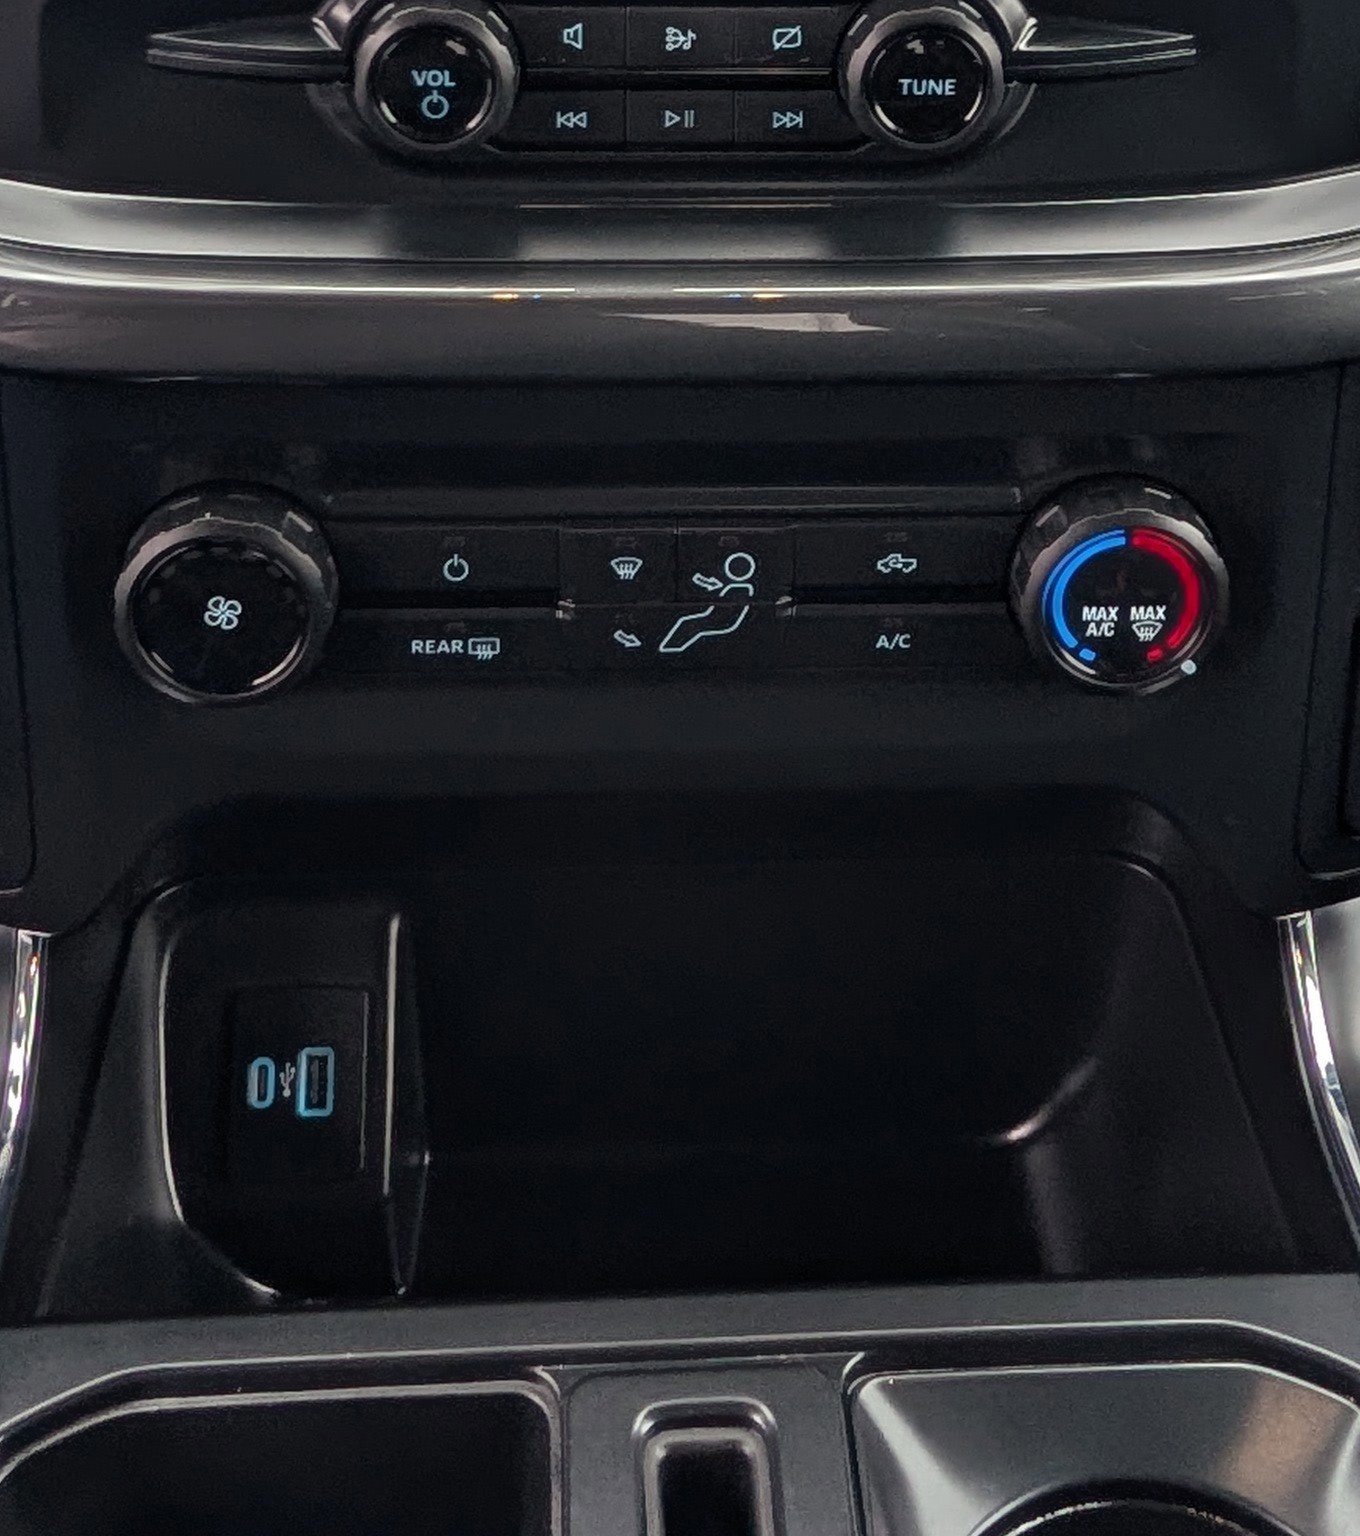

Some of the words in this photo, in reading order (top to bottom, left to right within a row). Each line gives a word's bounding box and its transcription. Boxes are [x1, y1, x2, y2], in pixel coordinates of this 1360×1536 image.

[411, 69, 456, 89] VOL
[898, 77, 957, 97] TUNE
[1082, 605, 1119, 622] MAX
[1129, 605, 1167, 621] MAX
[1085, 622, 1115, 637] A/C
[411, 639, 464, 655] REAR
[875, 633, 911, 650] A/C
